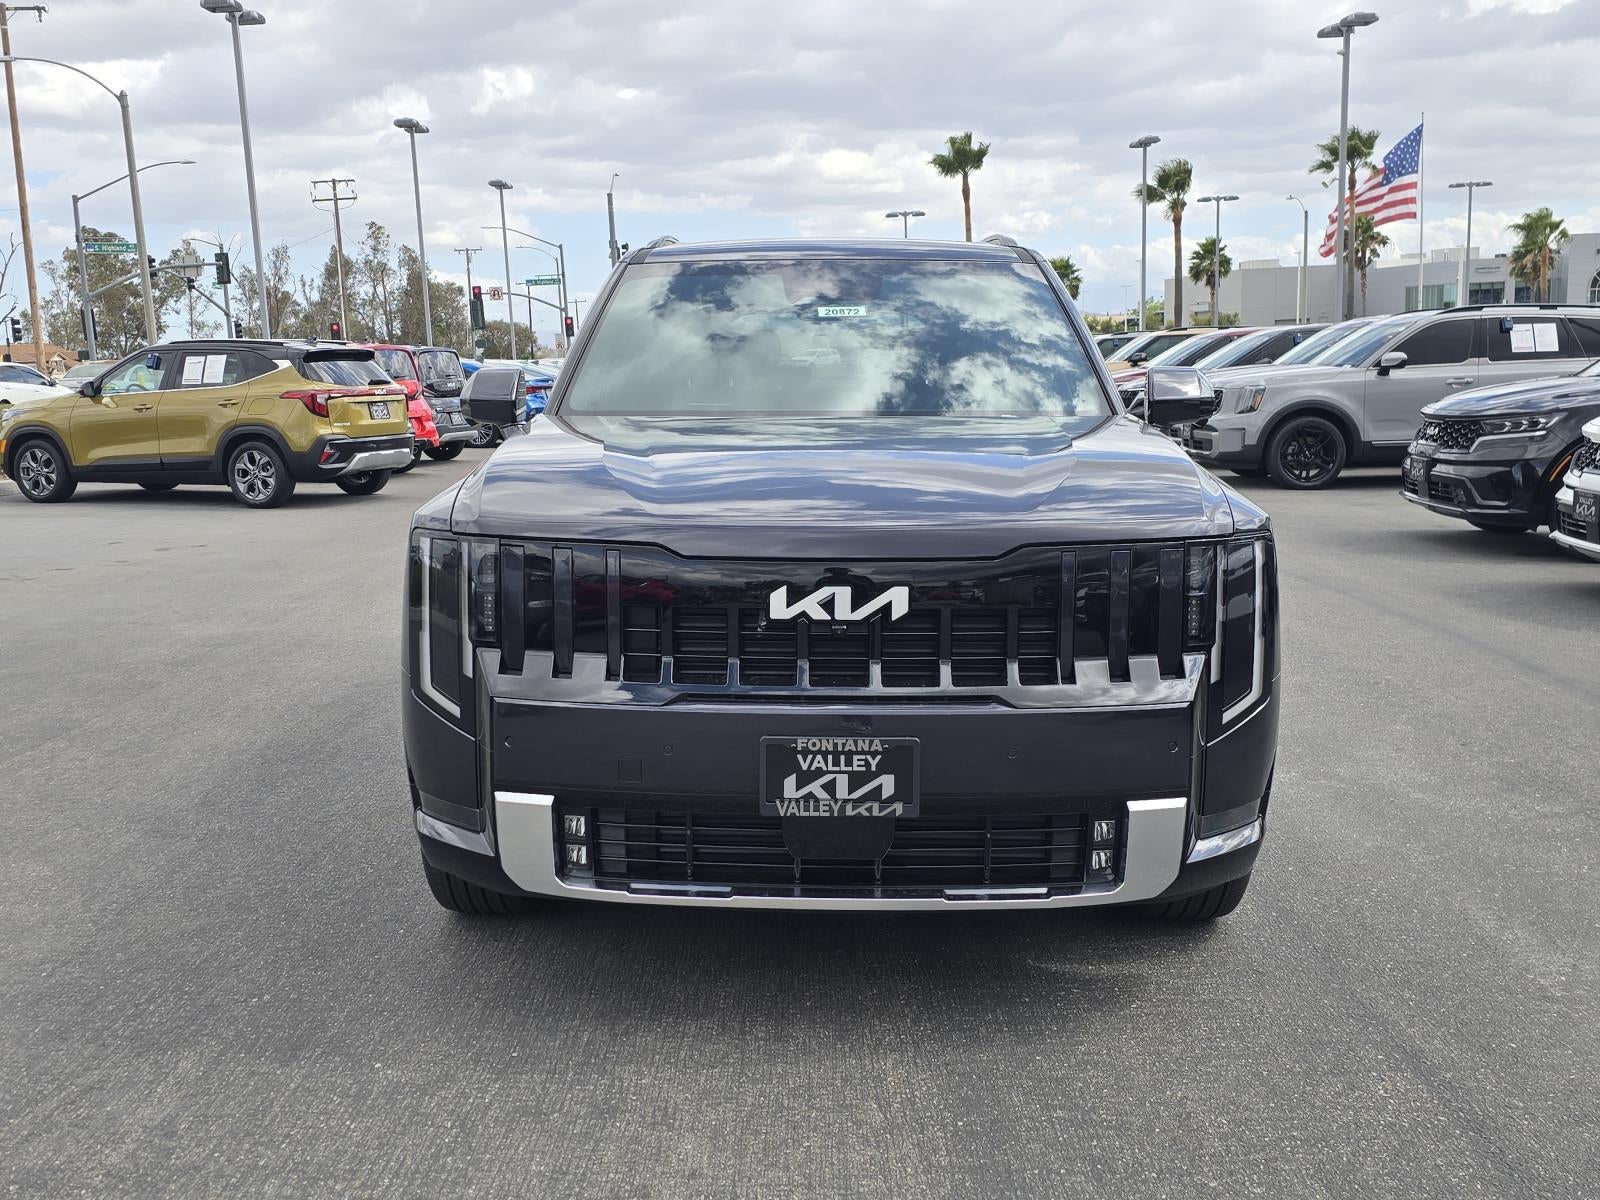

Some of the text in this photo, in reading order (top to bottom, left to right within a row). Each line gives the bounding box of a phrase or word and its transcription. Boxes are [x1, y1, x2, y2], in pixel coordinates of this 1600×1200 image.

[824, 308, 860, 316] 20872
[1579, 496, 1594, 506] VALLEY
[1576, 503, 1596, 516] KIA
[769, 585, 910, 622] KIA
[796, 738, 883, 751] FONTANA
[796, 754, 882, 771] VALLEY
[783, 773, 895, 800] KIA
[776, 799, 904, 817] VALLEY KIA
